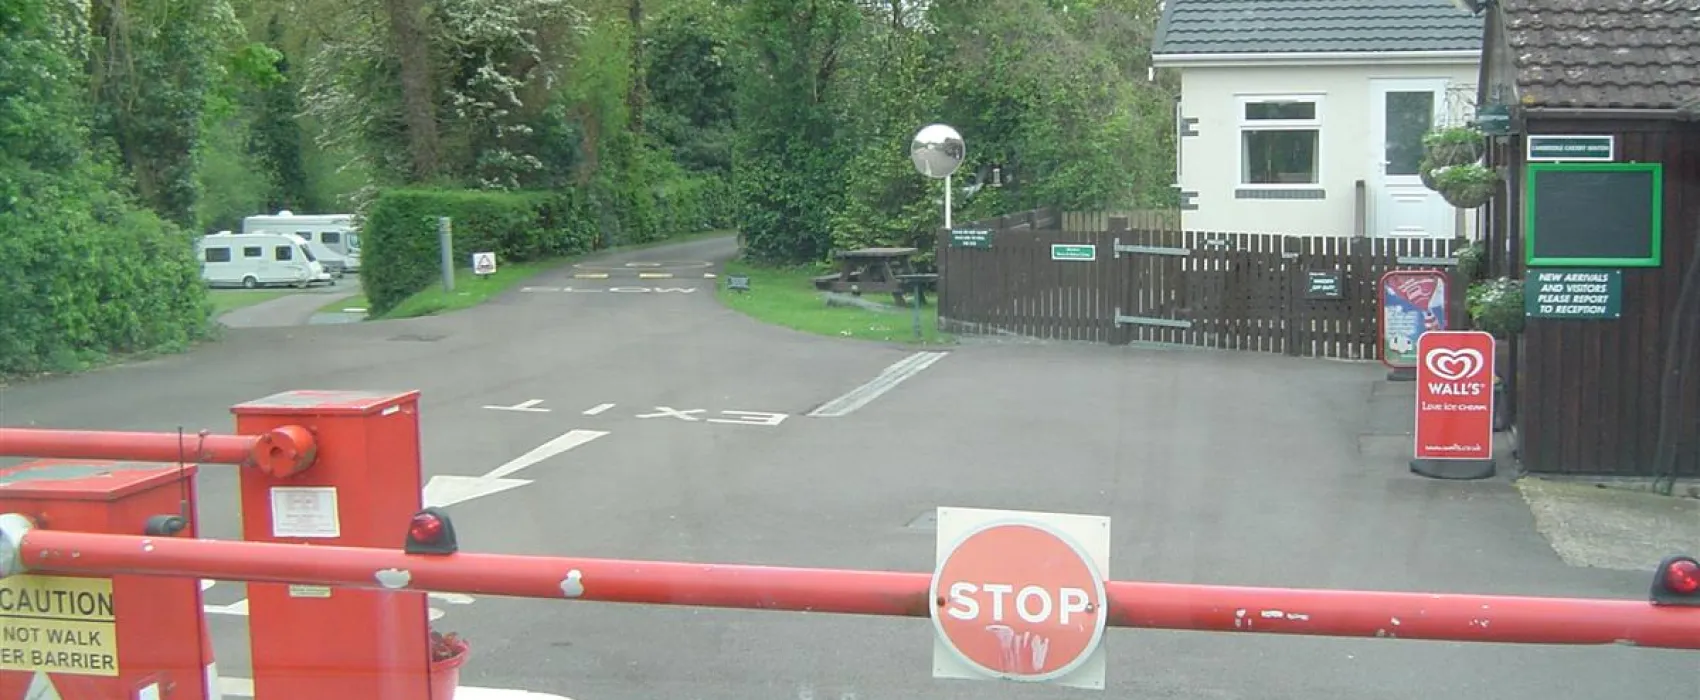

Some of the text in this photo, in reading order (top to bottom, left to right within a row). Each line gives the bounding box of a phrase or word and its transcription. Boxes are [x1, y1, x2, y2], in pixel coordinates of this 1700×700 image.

[1539, 273, 1608, 283] NEW ARRIVALS
[520, 286, 697, 294] SLOW
[1541, 284, 1607, 293] AND VISITORS
[1538, 294, 1609, 303] PLEASE REPORT
[1540, 305, 1606, 314] TO RECEPTION
[1427, 382, 1480, 395] WALL'S
[481, 398, 790, 426] EXIT
[0, 587, 115, 616] CAUTION
[947, 581, 1090, 626] STOP
[3, 626, 102, 647] NOT WALK
[31, 650, 115, 670] BARRIER
